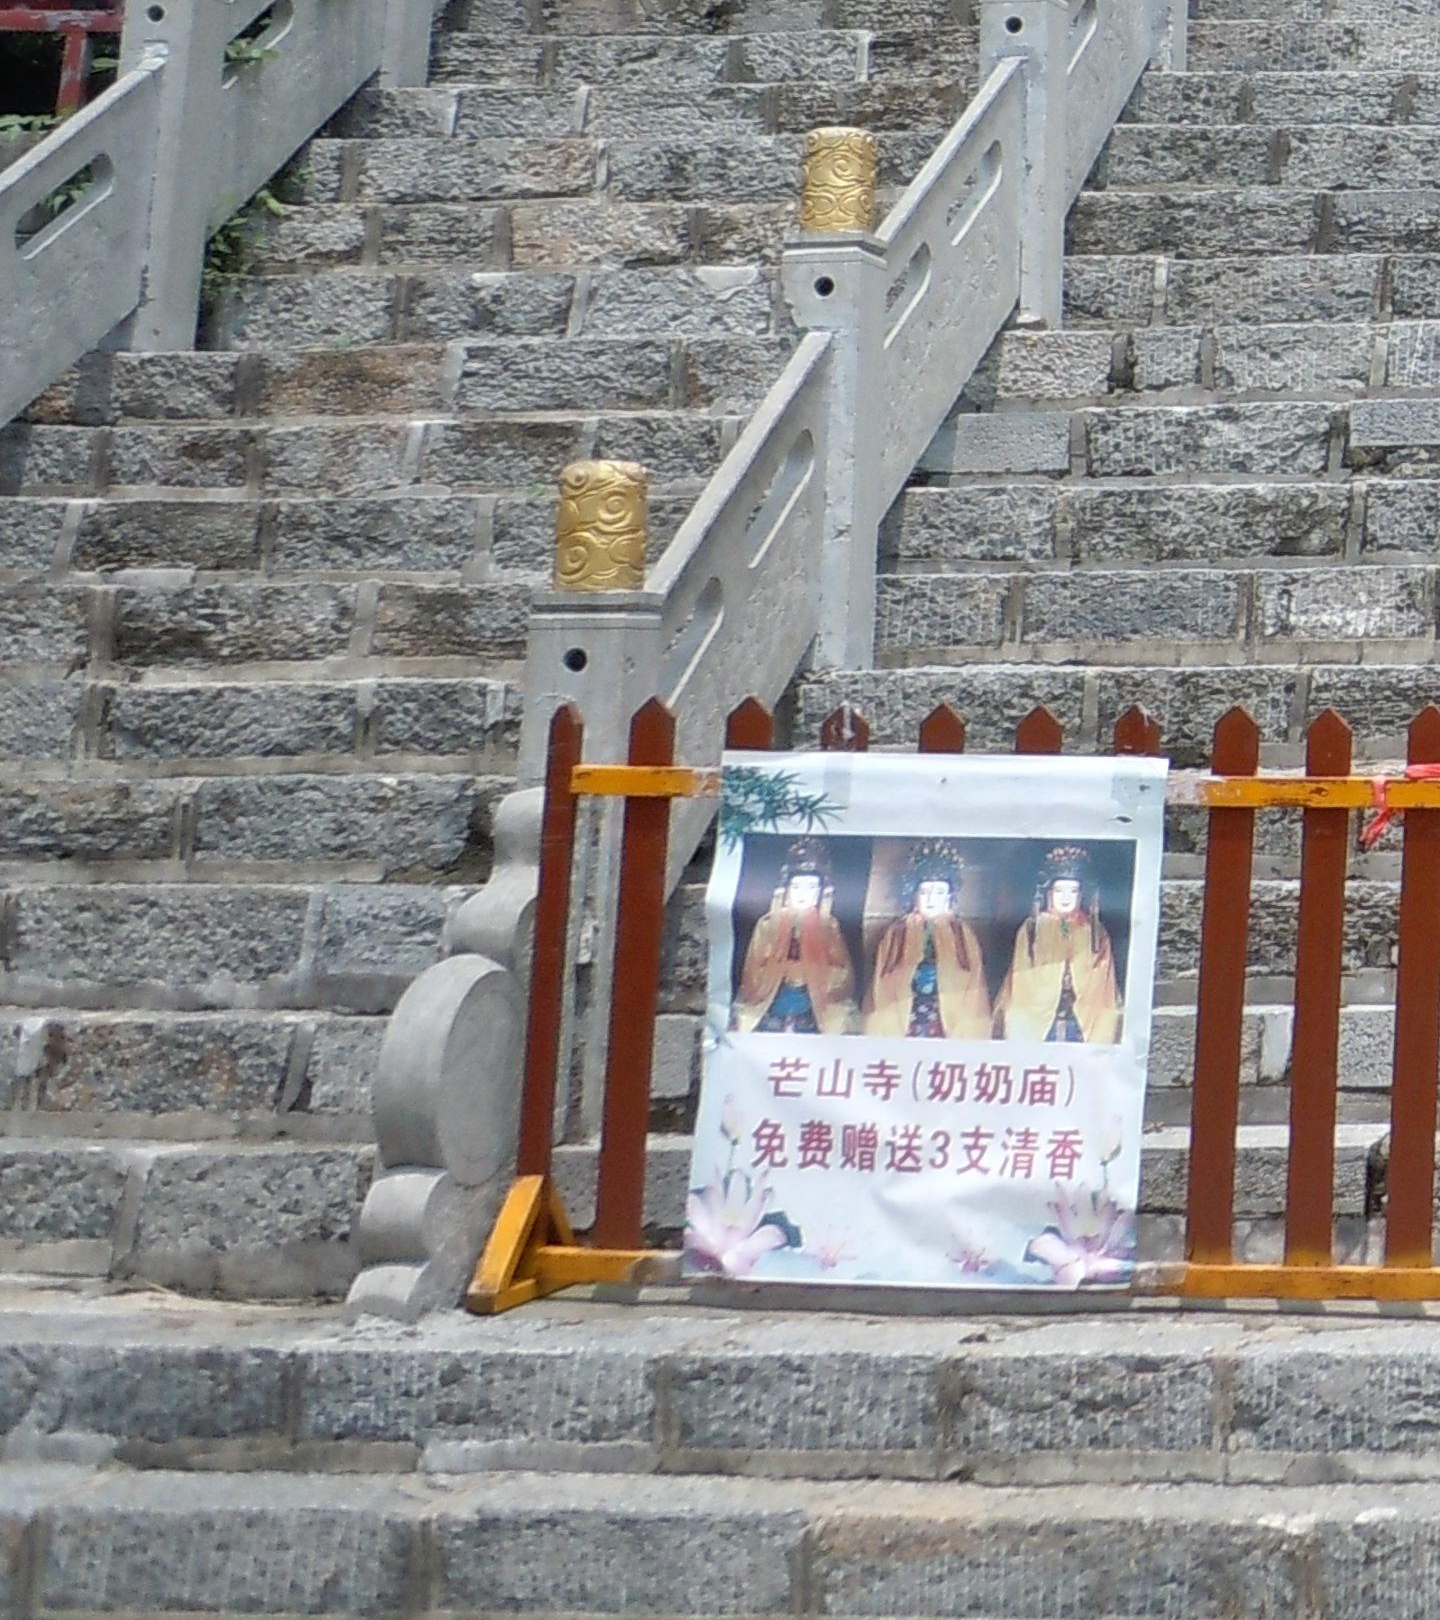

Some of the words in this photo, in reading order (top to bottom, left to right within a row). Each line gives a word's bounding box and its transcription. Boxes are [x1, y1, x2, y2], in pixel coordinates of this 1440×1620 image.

[750, 1117, 1084, 1181] 免费赠送3支清香
